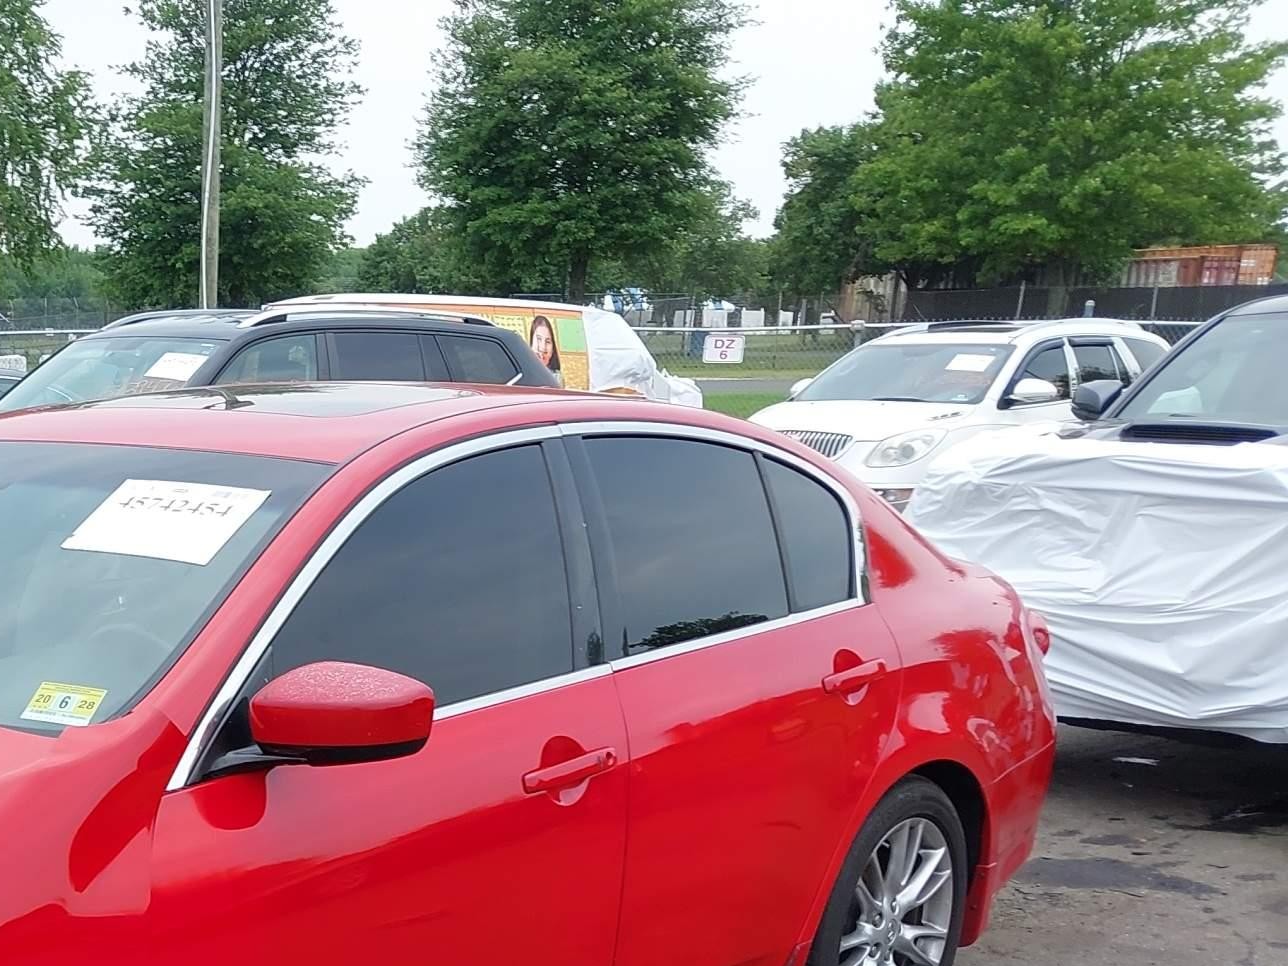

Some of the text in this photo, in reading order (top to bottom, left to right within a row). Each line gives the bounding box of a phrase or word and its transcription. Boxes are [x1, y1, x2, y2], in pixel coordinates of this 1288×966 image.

[714, 339, 736, 349] DZ
[719, 350, 728, 360] 6
[119, 496, 233, 518] 45742454
[35, 694, 96, 710] 20 6 28
